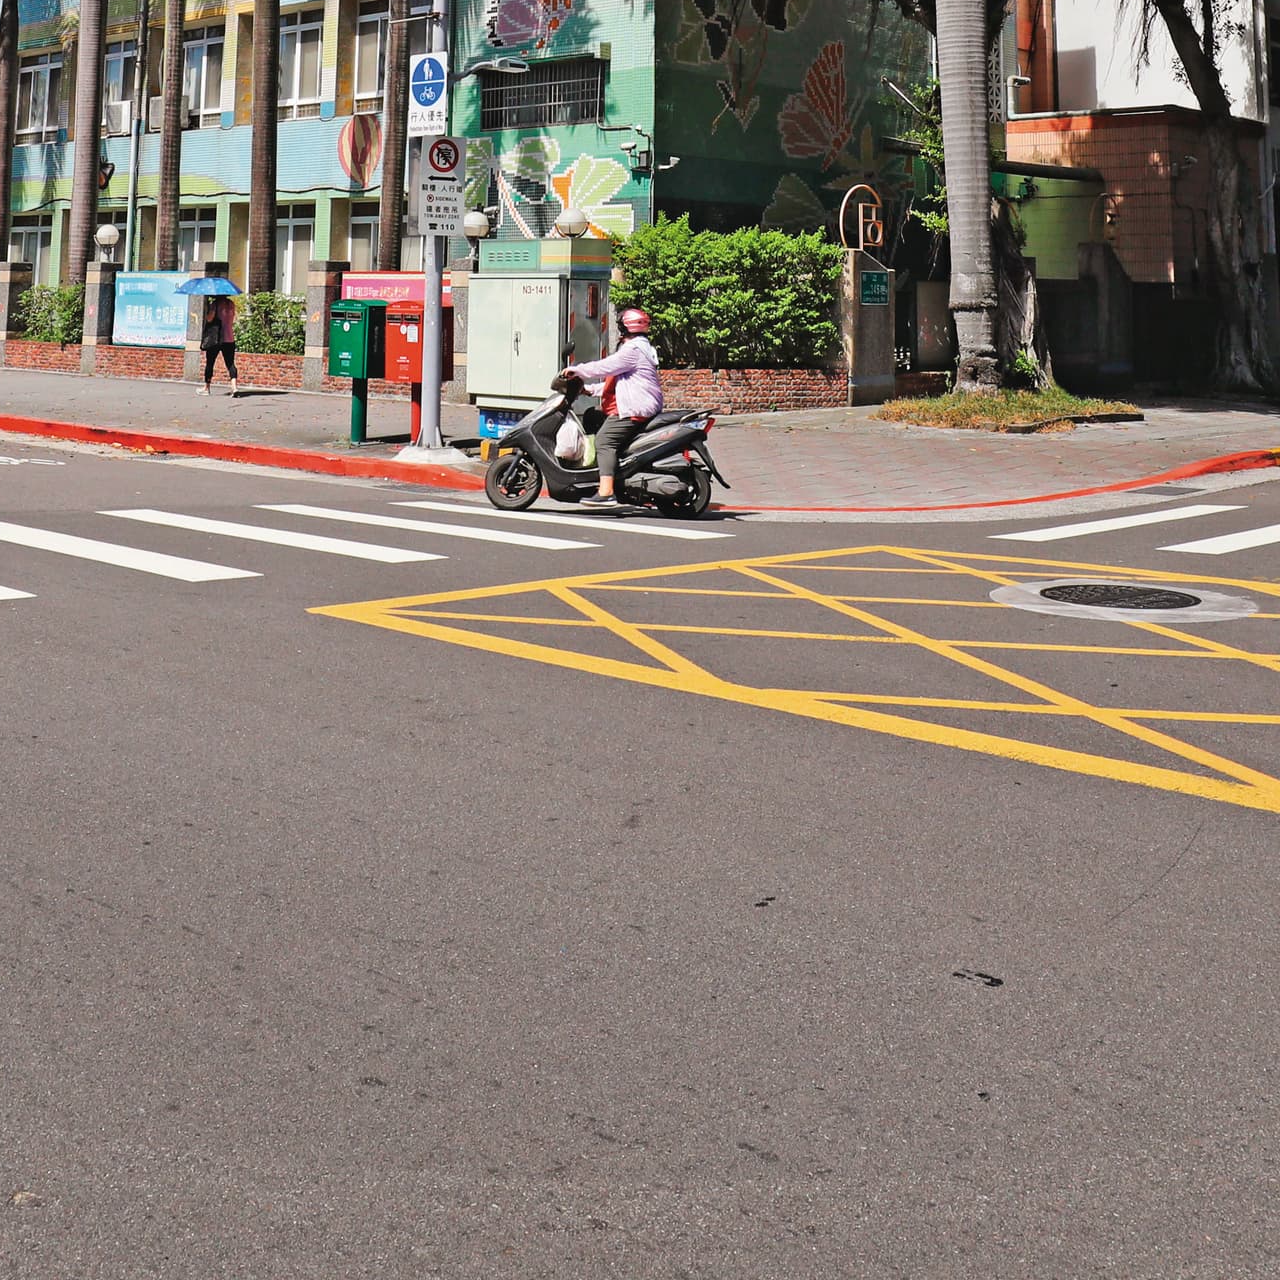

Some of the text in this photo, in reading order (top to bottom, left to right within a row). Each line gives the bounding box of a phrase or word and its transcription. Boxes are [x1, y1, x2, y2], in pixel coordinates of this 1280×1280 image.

[411, 111, 444, 122] 行人優先
[441, 223, 455, 231] 110
[522, 285, 552, 295] N3-1411
